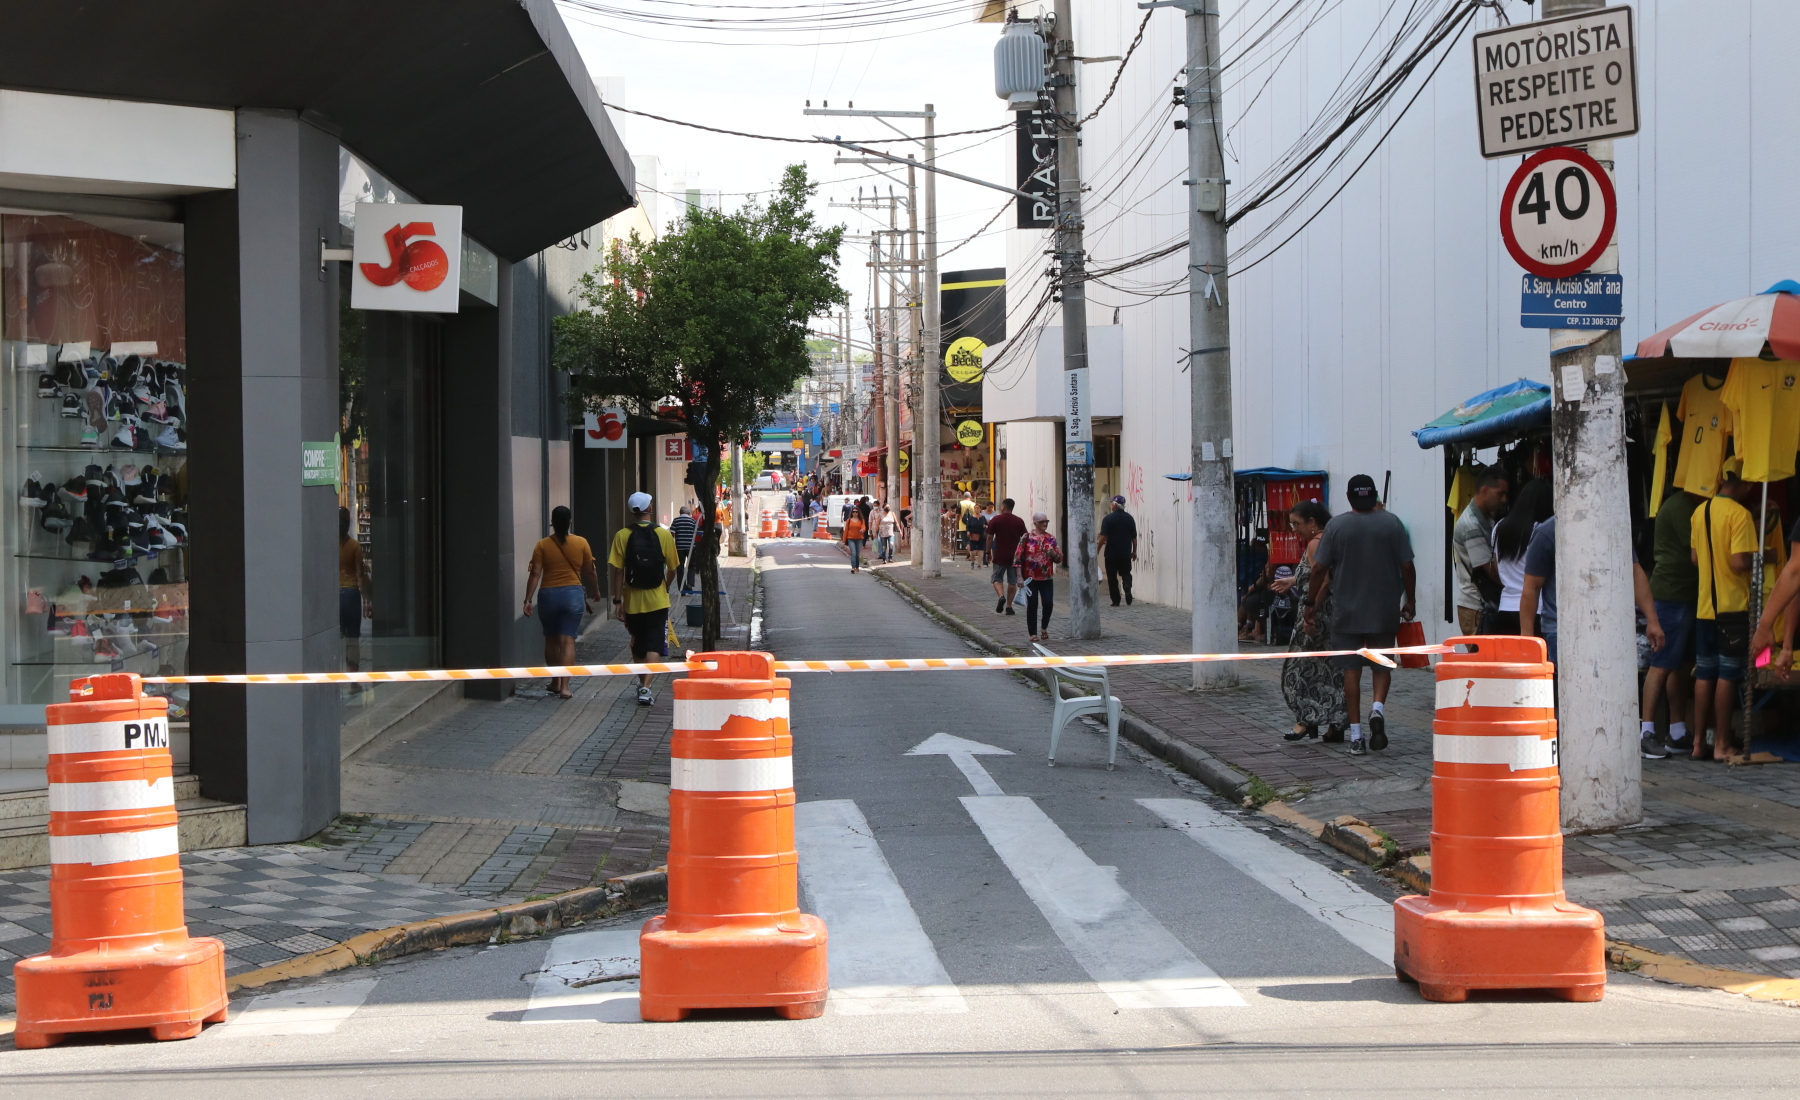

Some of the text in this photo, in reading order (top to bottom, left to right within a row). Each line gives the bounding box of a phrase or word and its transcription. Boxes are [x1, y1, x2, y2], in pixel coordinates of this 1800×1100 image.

[1486, 23, 1621, 73] MOTORISTA
[1489, 61, 1622, 106] RESPEITE O
[1501, 97, 1618, 143] PEDESTRE
[1518, 166, 1591, 225] 40
[1541, 239, 1579, 260] km/h
[409, 259, 439, 273] CALÇADOS
[1523, 278, 1531, 295] R.
[1533, 278, 1554, 298] Sarg.
[1555, 277, 1582, 295] Acrisio
[1554, 299, 1587, 309] Centro
[1567, 317, 1619, 326] CEP. 12 308-320
[1699, 320, 1749, 332] Claro
[951, 354, 982, 369] Becke
[1069, 373, 1078, 396] Santana
[303, 450, 325, 467] COMPRE
